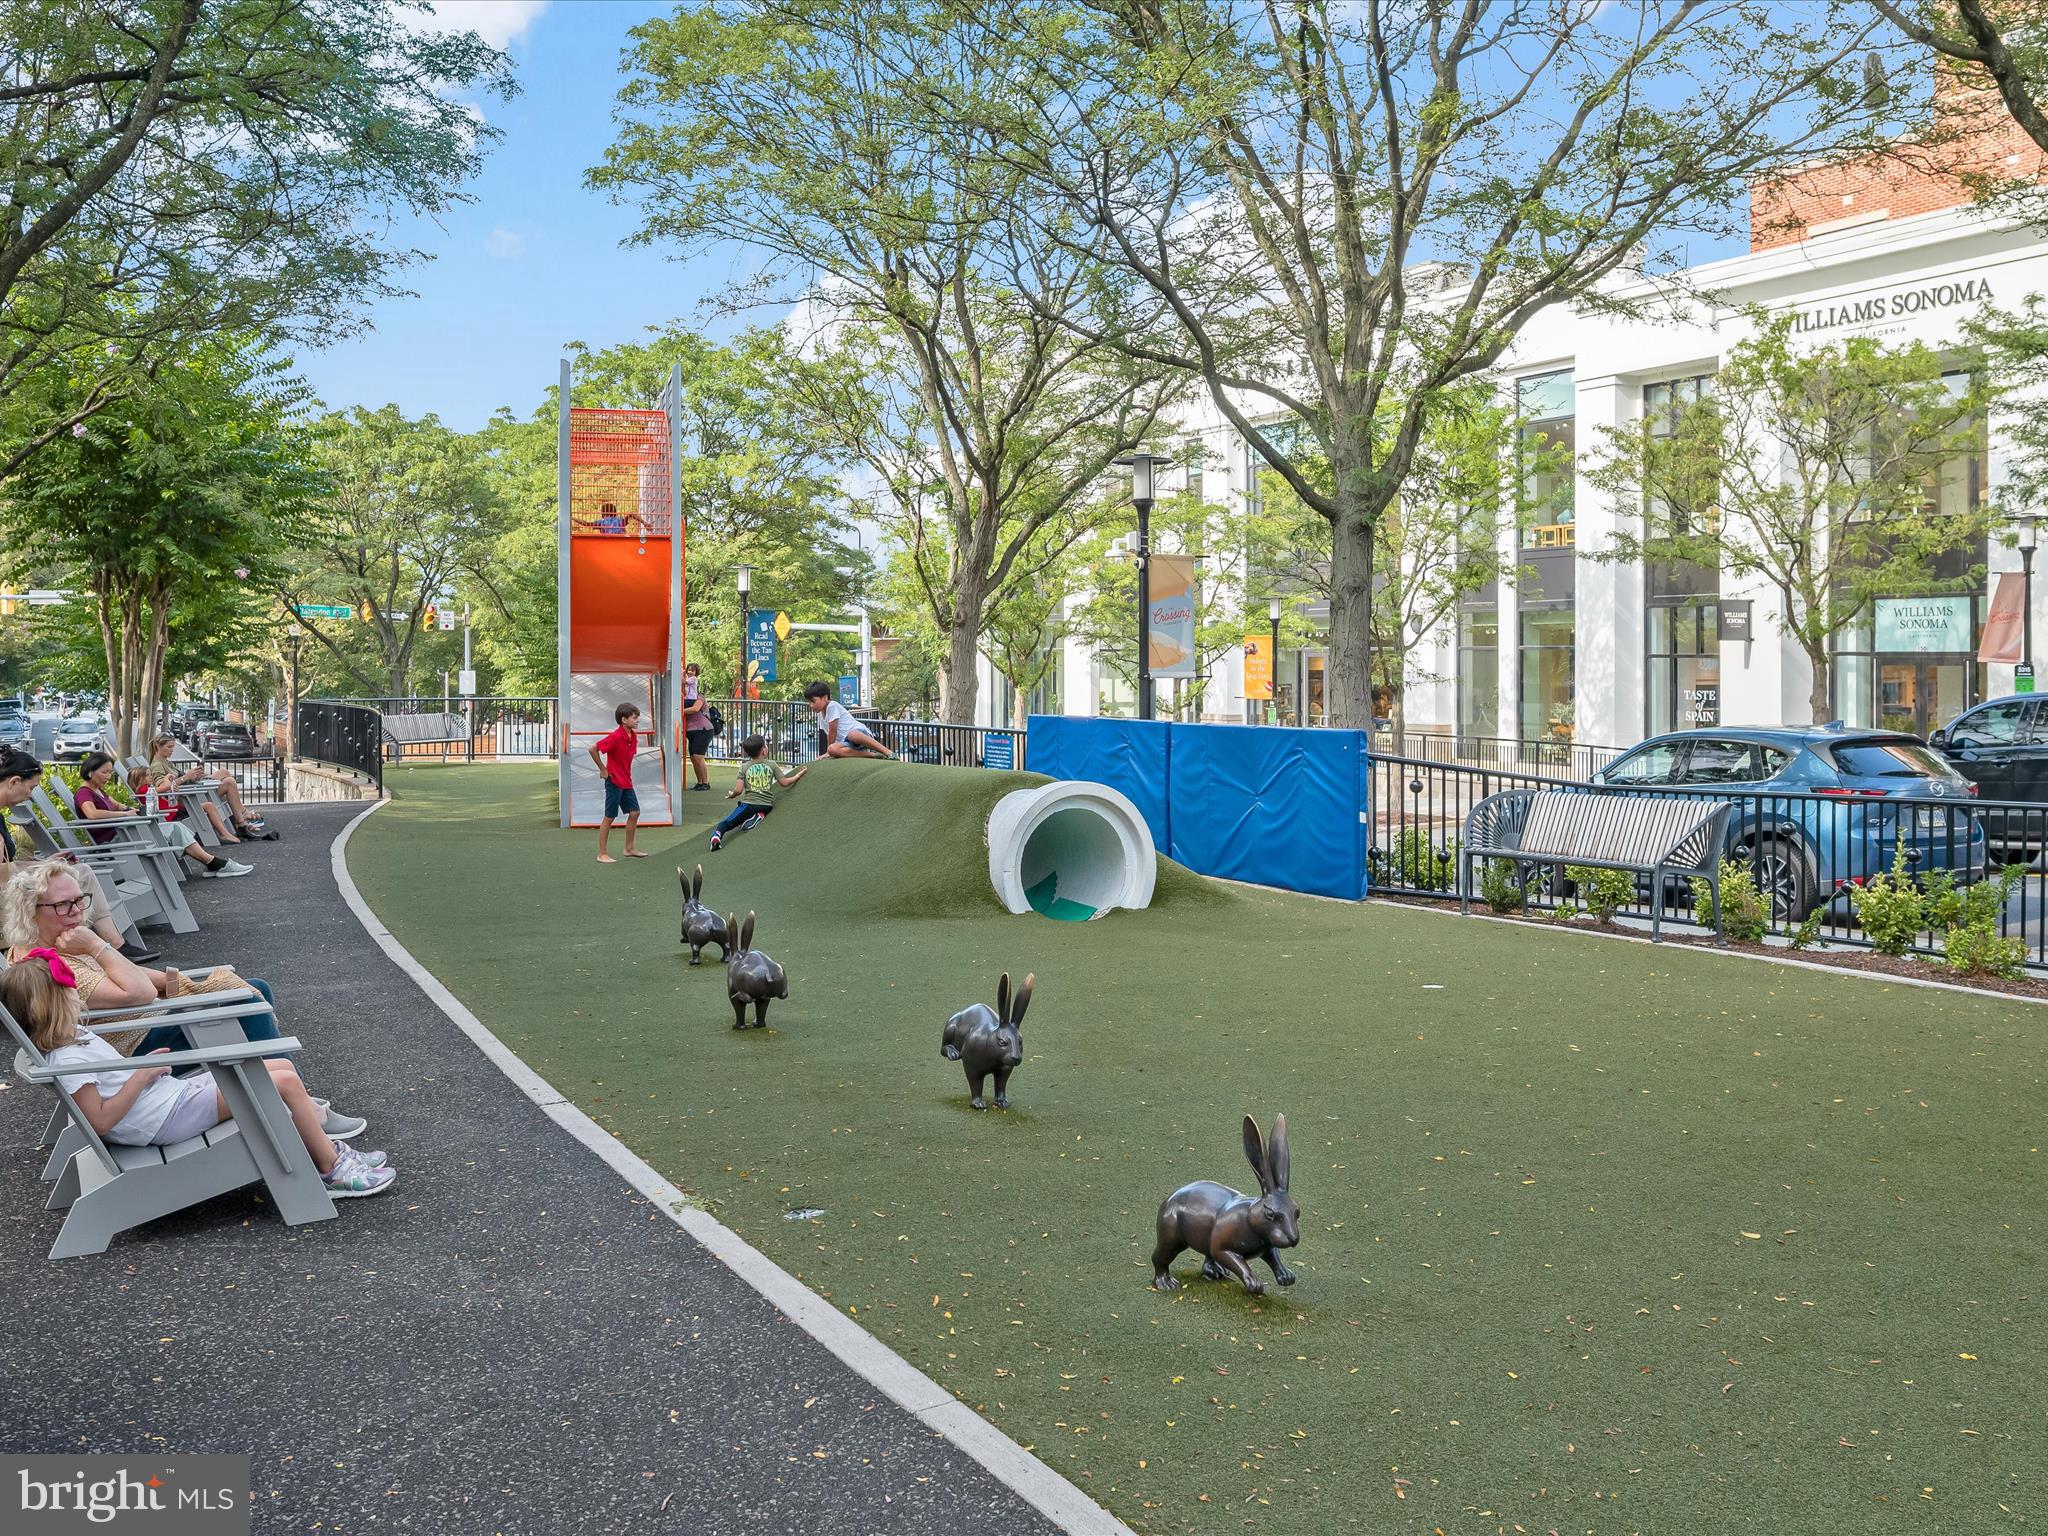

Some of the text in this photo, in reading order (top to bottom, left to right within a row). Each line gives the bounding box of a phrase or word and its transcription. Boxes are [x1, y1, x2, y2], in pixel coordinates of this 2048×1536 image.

[1891, 277, 1995, 316] SONOMA
[1854, 326, 1907, 339] LIFORNIA
[1152, 607, 1191, 625] Crossing
[1894, 606, 1954, 617] WILLIAMS
[1899, 619, 1948, 629] SONOMA
[754, 632, 768, 640] Read
[1683, 690, 1716, 701] TASTE
[1695, 700, 1706, 711] of
[1685, 711, 1714, 722] SPAIN
